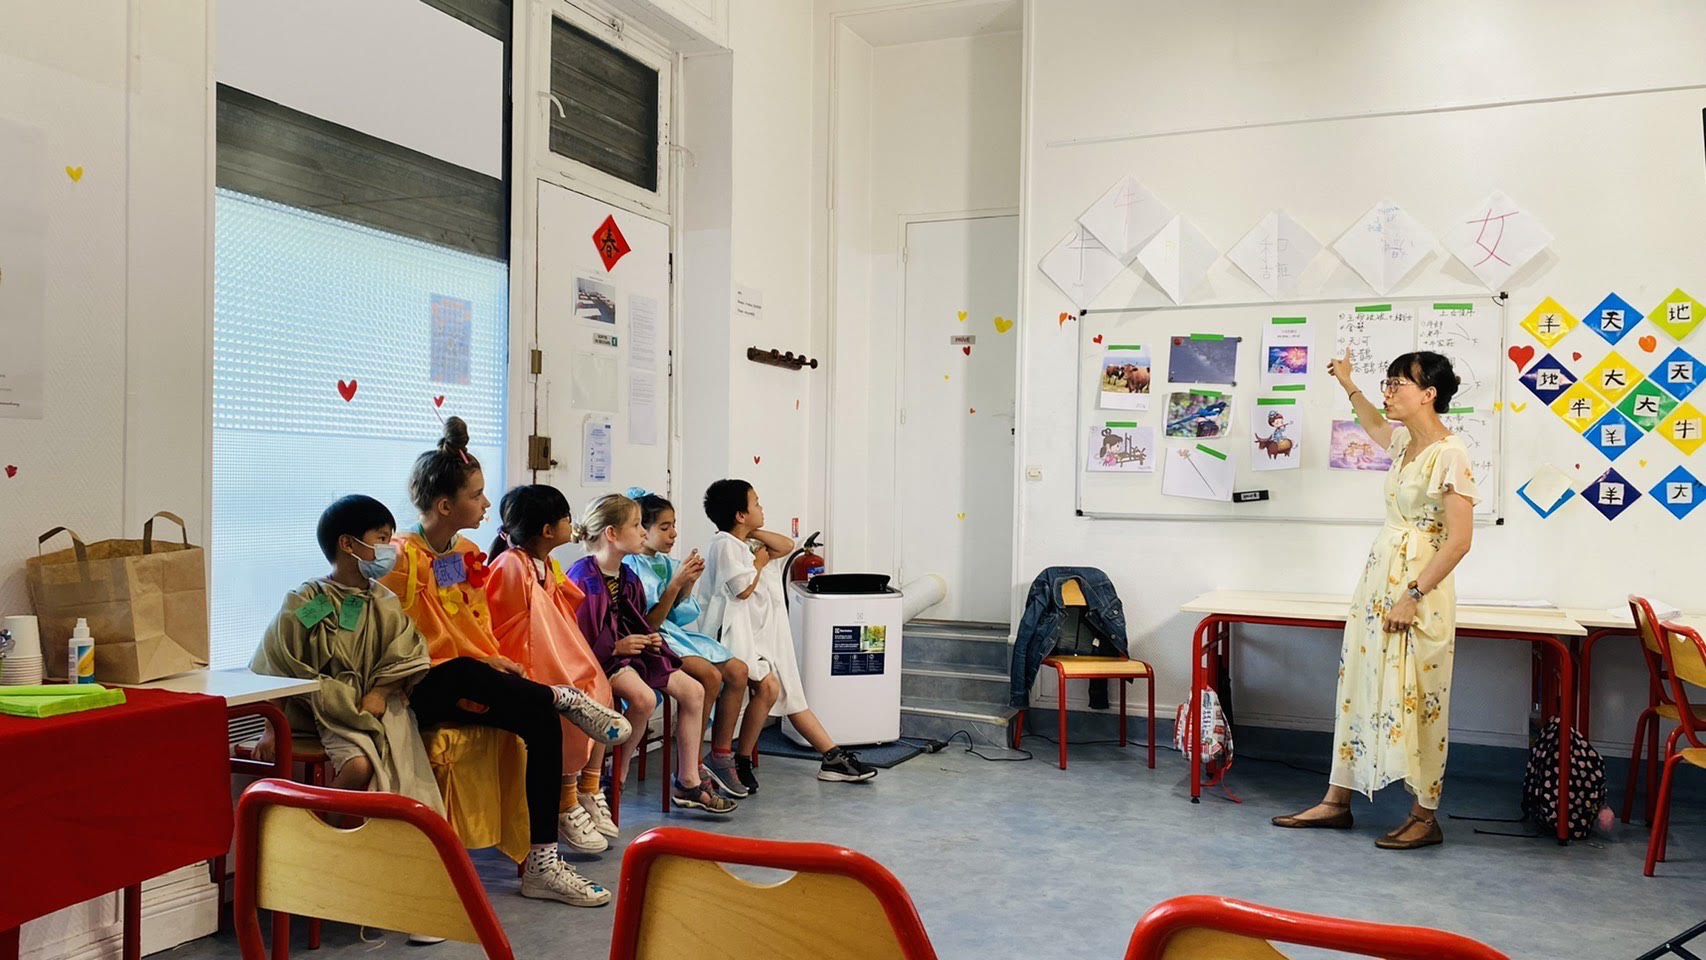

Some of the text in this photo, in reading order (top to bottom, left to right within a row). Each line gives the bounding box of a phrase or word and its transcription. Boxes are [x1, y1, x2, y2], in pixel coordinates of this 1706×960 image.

[600, 225, 619, 258] 春
[1466, 208, 1519, 267] 女
[1601, 311, 1622, 330] 天
[1668, 304, 1690, 321] 地
[1538, 315, 1560, 333] 羊
[1540, 372, 1559, 387] 地
[1604, 369, 1625, 386] 大
[1671, 363, 1689, 380] 天
[1635, 397, 1659, 413] 大
[1605, 428, 1622, 445] 羊
[1675, 419, 1695, 439] 牛
[1601, 486, 1621, 504] 羊
[1671, 484, 1688, 499] 大
